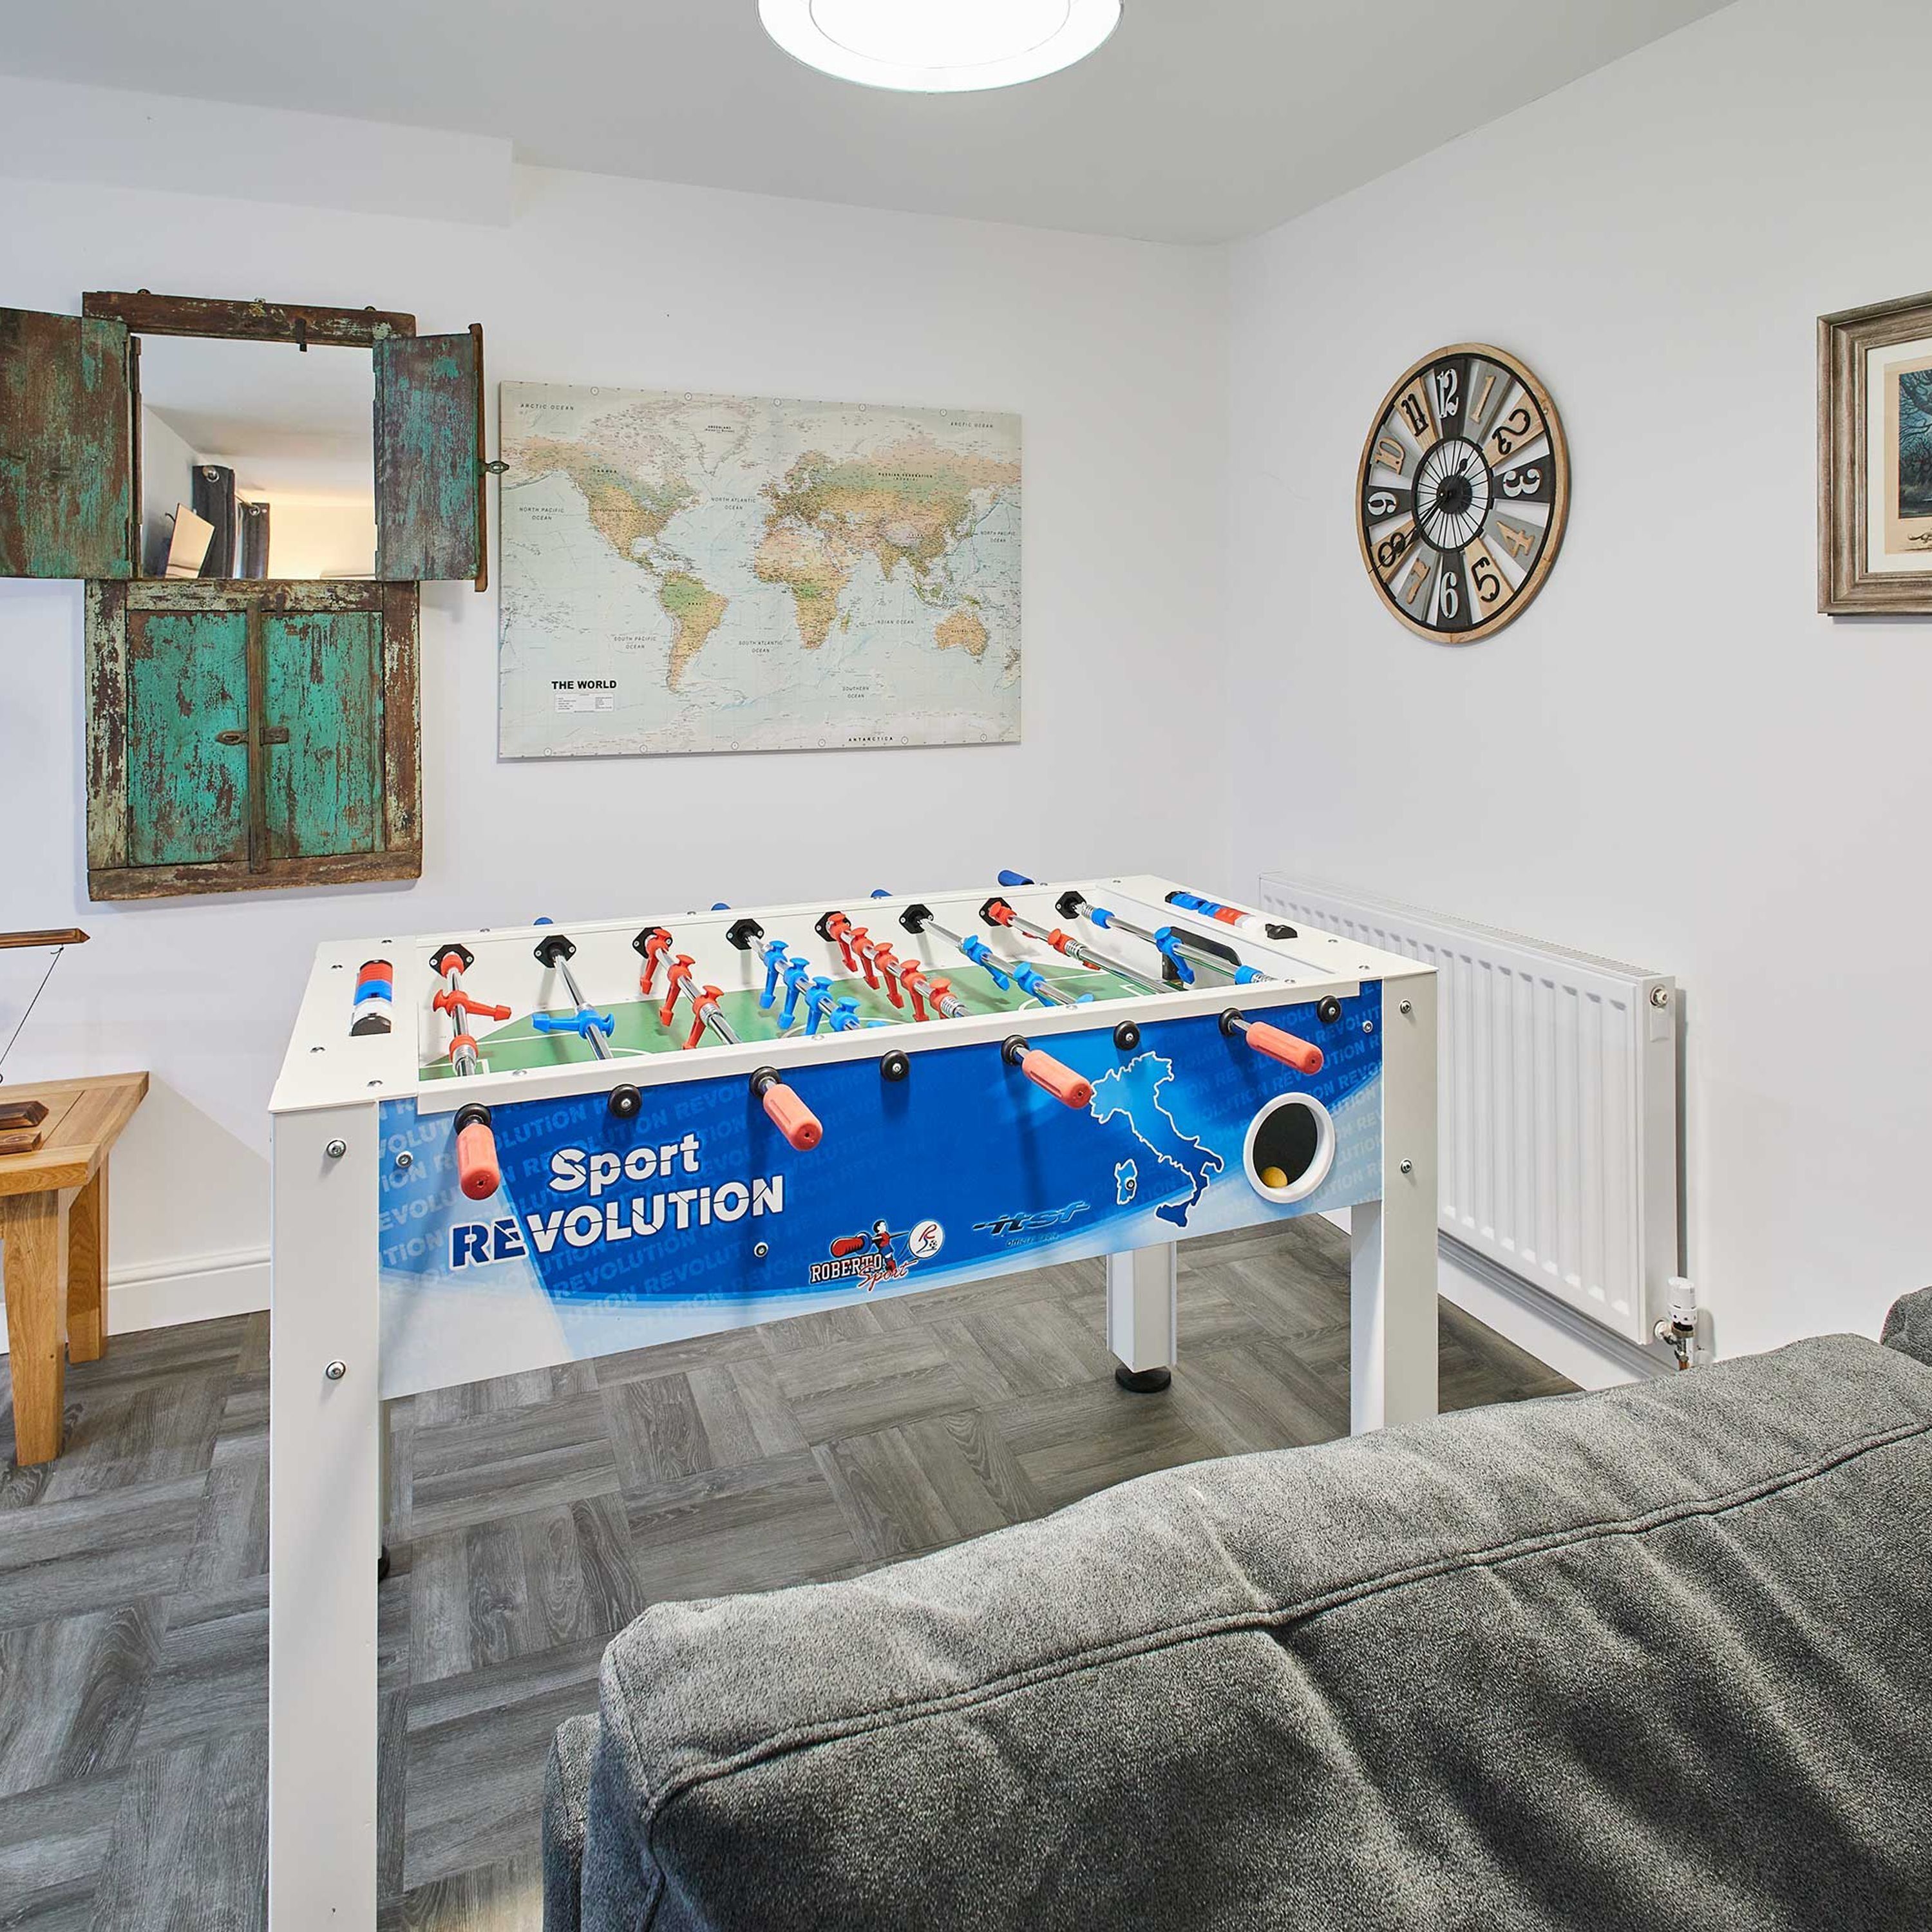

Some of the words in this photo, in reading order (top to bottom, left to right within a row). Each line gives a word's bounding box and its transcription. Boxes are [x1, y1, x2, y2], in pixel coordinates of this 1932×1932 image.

[1401, 393, 1429, 437] 11
[1437, 368, 1459, 419] 12
[1470, 375, 1497, 424] 1
[1492, 408, 1531, 455] 2
[1502, 468, 1542, 498] 3
[1377, 532, 1406, 568] 8
[1496, 520, 1535, 558] 4
[1406, 556, 1431, 605] 7
[1439, 571, 1459, 620] 6
[1471, 556, 1501, 604] 5
[551, 681, 574, 689] THE
[577, 680, 617, 689] WORLD
[549, 1133, 699, 1197] Sport
[449, 1175, 784, 1272] REVOLUTION
[810, 1254, 883, 1283] ROBERTO
[858, 1259, 918, 1292] Sport
